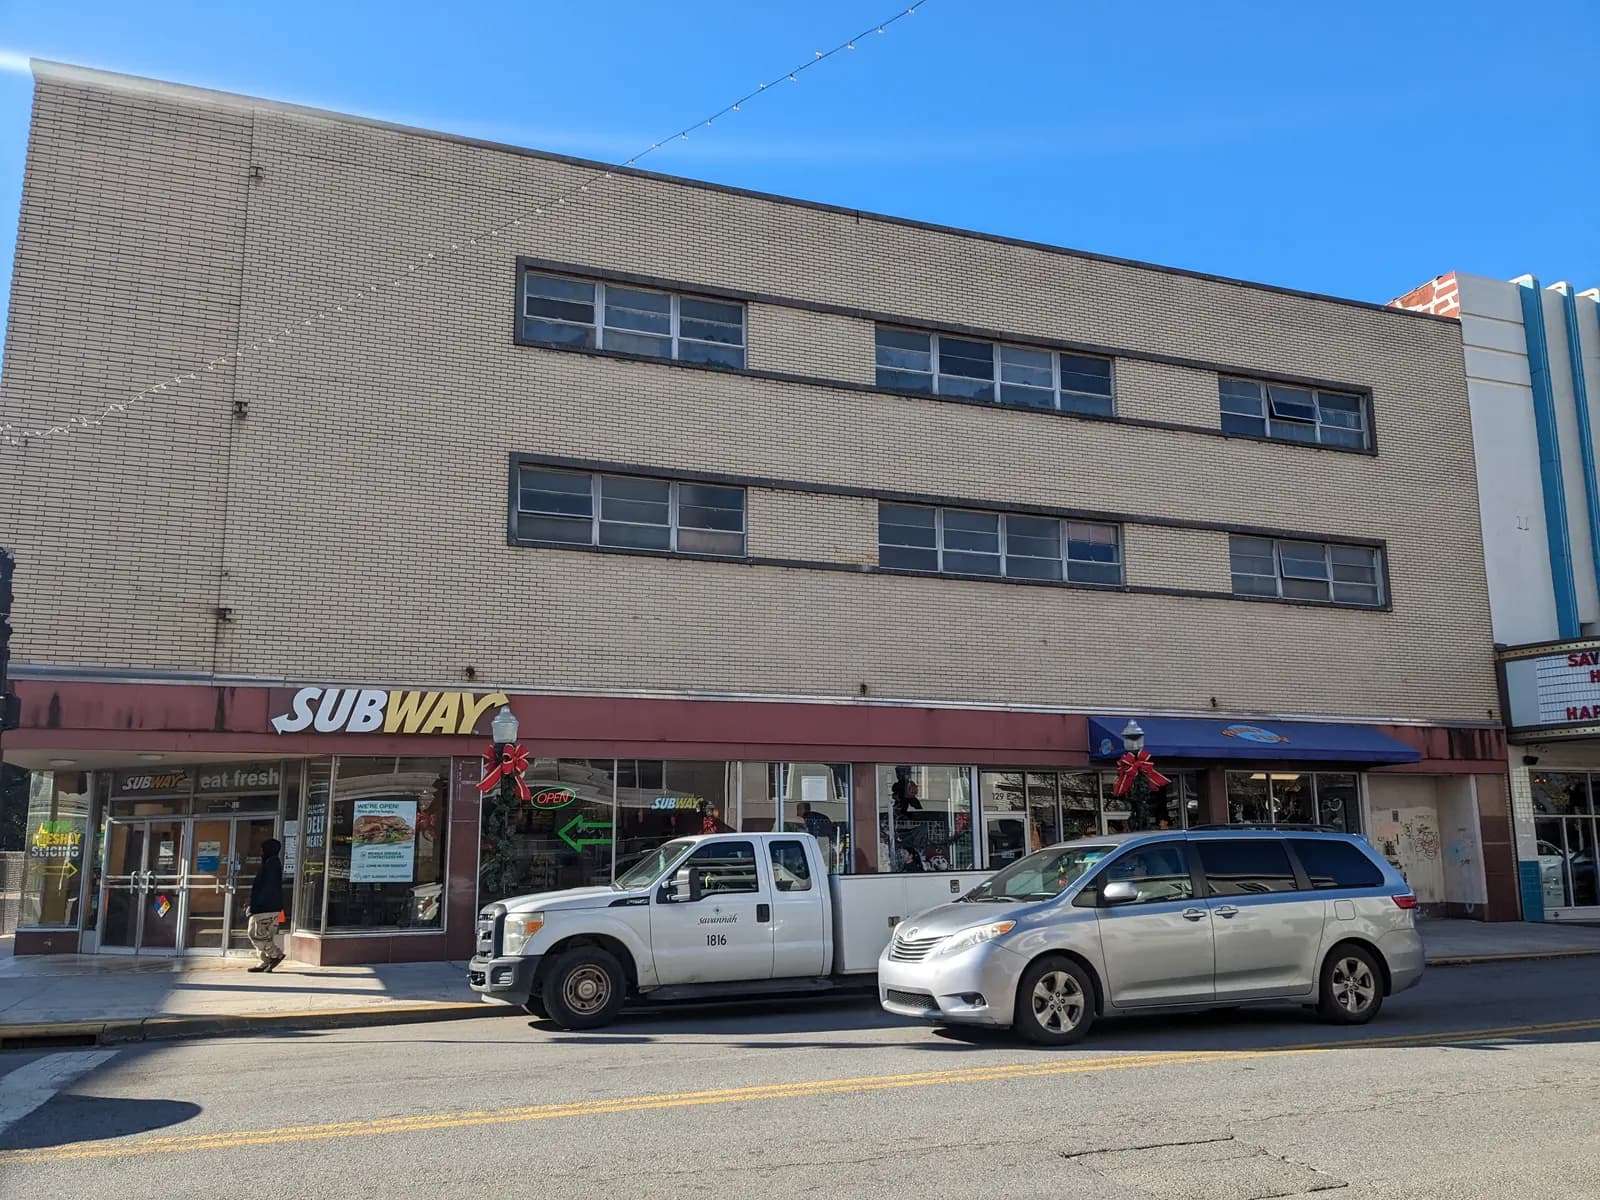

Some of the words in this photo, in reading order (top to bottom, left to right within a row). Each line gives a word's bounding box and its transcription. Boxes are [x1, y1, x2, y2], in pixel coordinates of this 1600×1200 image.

[1567, 652, 1599, 667] SAV
[271, 687, 509, 735] SUBWAY
[122, 773, 185, 791] SUBWAY
[201, 773, 228, 788] eat
[234, 768, 279, 787] fresh
[537, 791, 569, 804] OPEN
[651, 797, 704, 809] SUBWAY
[992, 792, 1004, 801] 129
[307, 815, 324, 834] DELI
[32, 833, 80, 845] RESHY
[31, 846, 79, 857] SLICING
[707, 934, 727, 946] 1816
